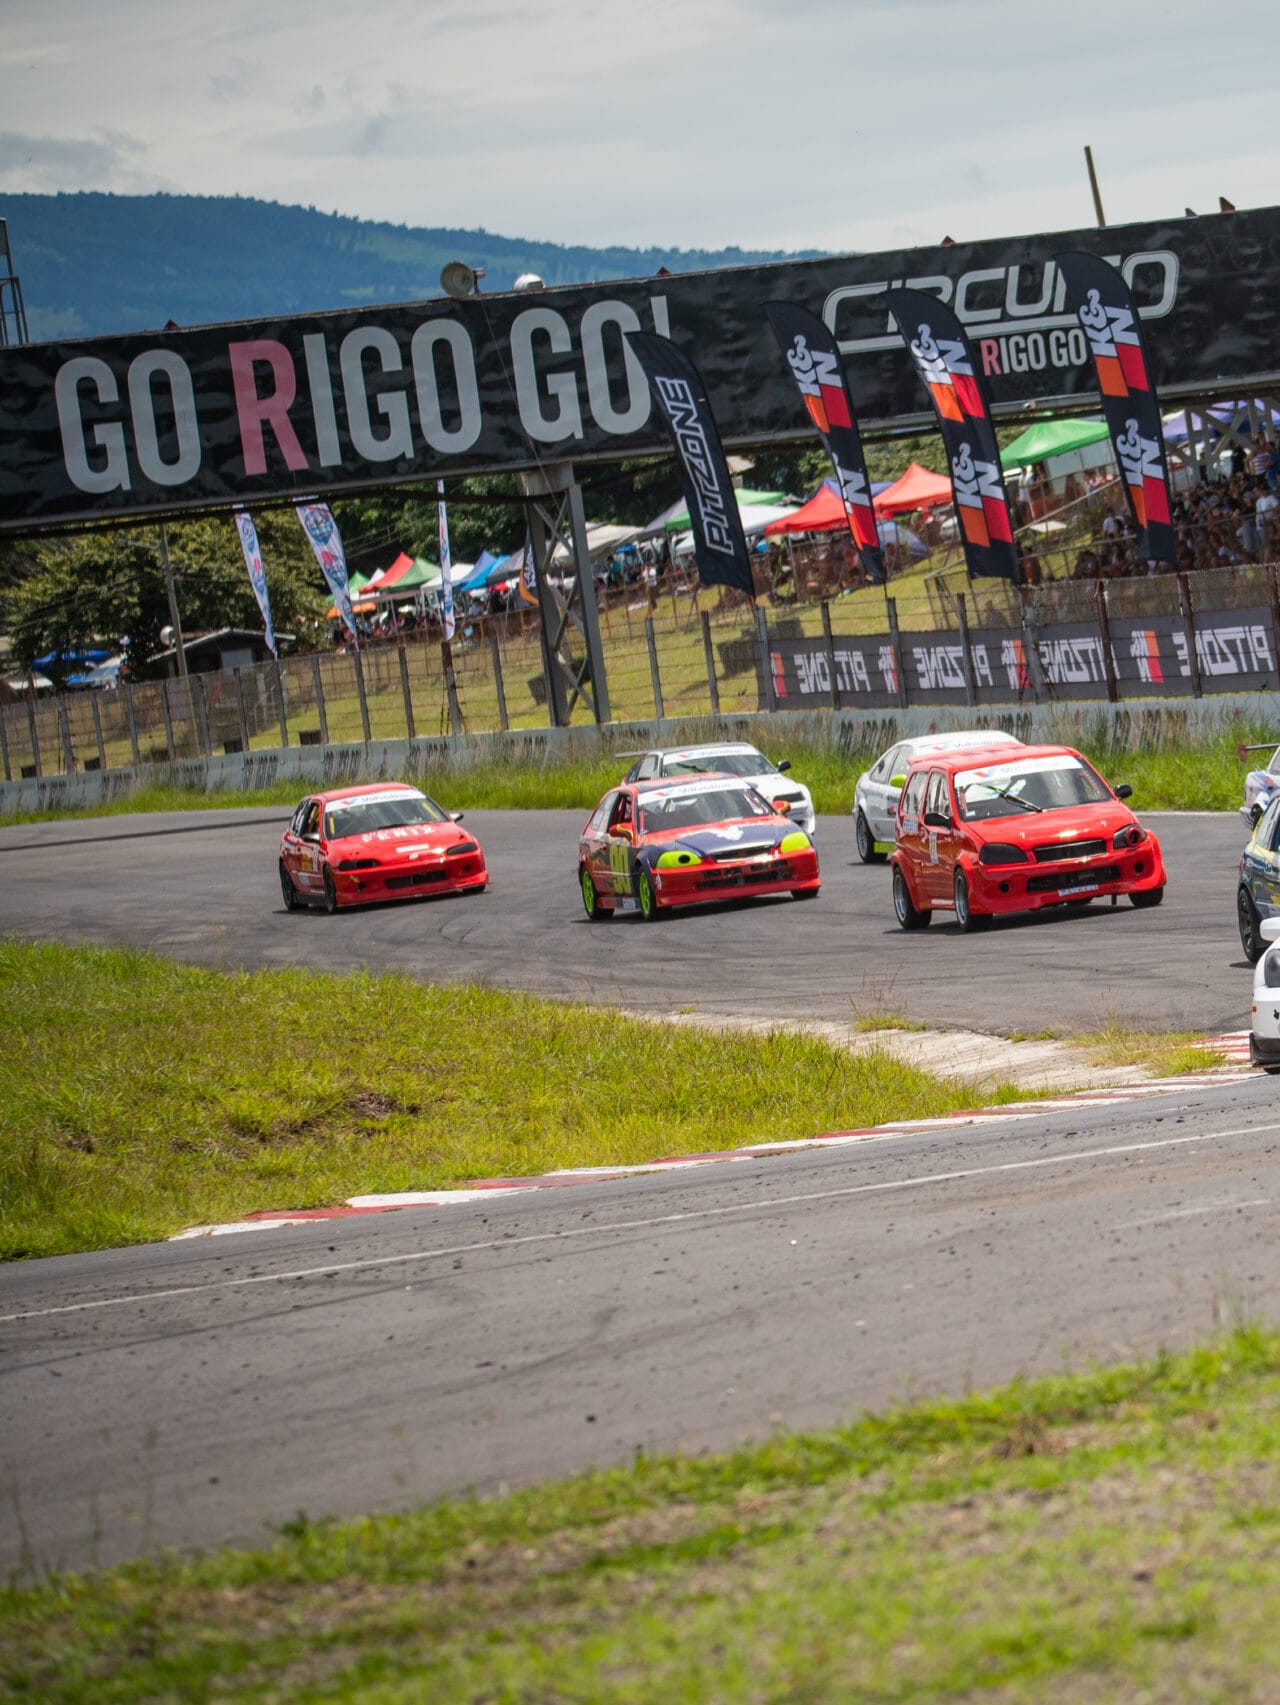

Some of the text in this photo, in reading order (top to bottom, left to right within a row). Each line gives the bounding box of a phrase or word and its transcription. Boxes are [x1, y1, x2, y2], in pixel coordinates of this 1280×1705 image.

[55, 349, 202, 493] GO
[228, 318, 482, 476] RIGO
[980, 330, 1088, 376] RIGO GO
[655, 375, 735, 556] PITZONE
